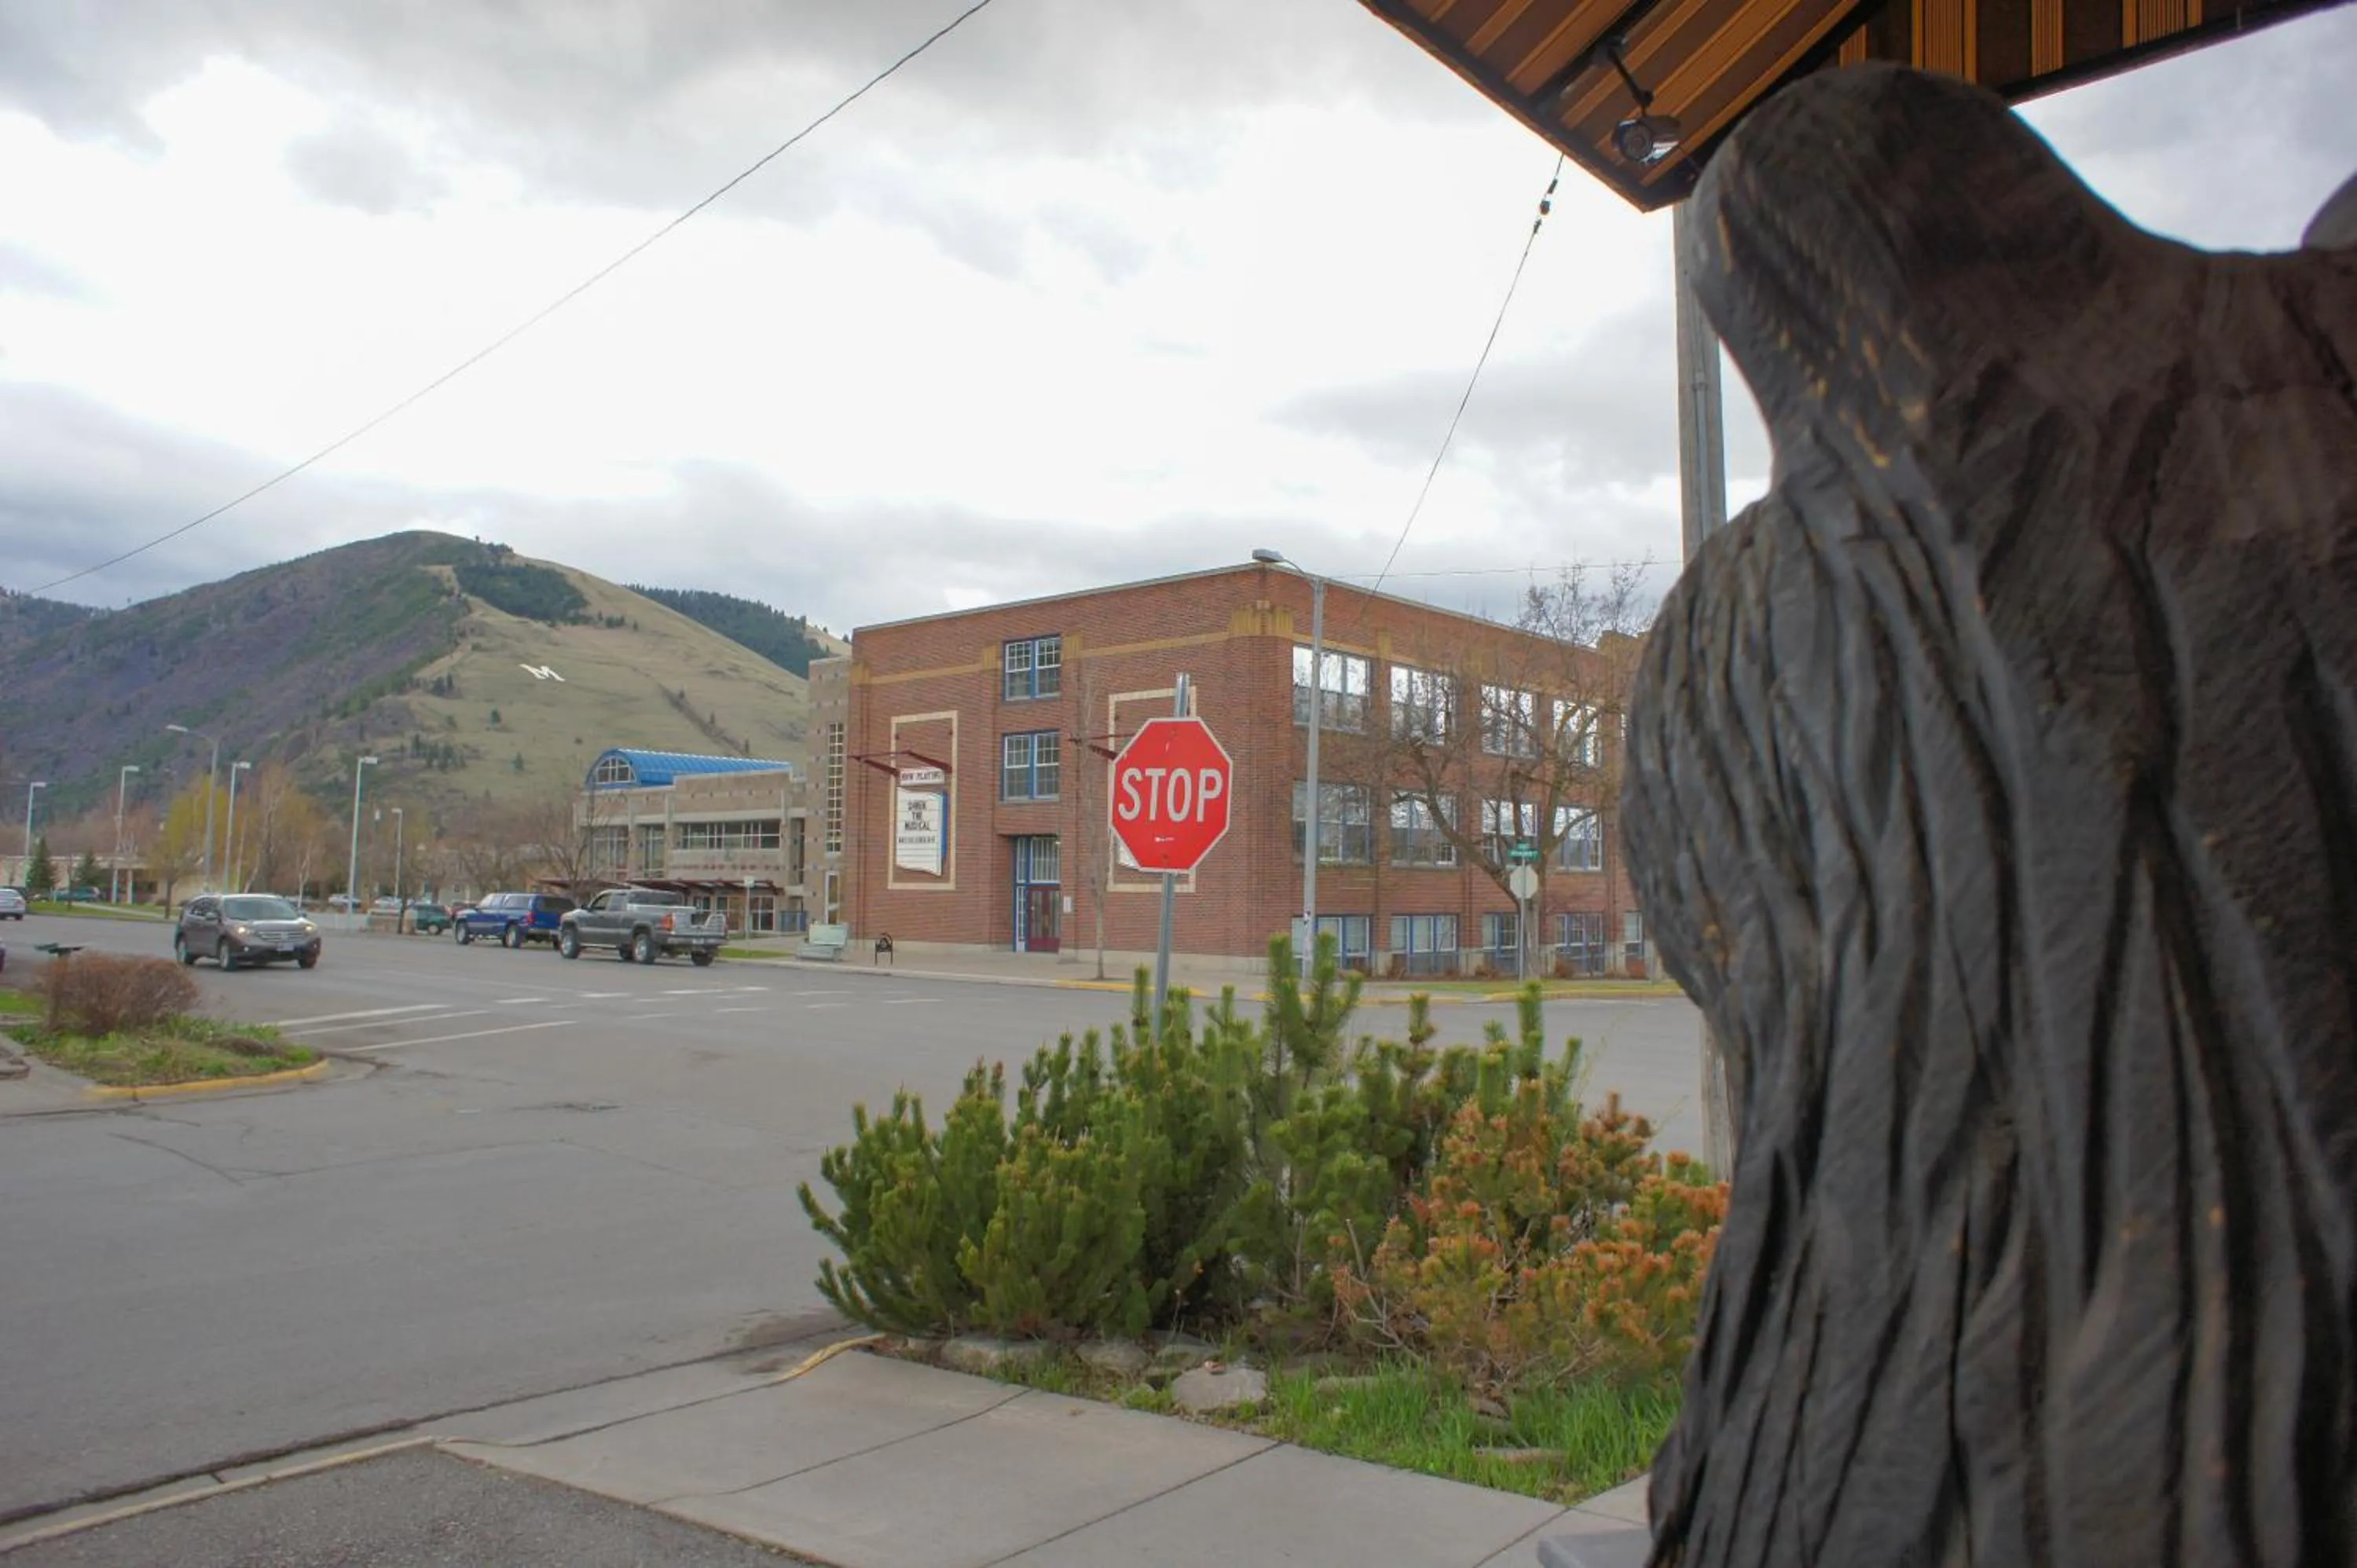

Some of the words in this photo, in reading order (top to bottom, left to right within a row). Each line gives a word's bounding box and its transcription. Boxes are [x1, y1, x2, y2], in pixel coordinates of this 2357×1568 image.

[1118, 768, 1222, 822] STOP
[912, 811, 922, 820] THE
[904, 821, 930, 831] MUSICAL
